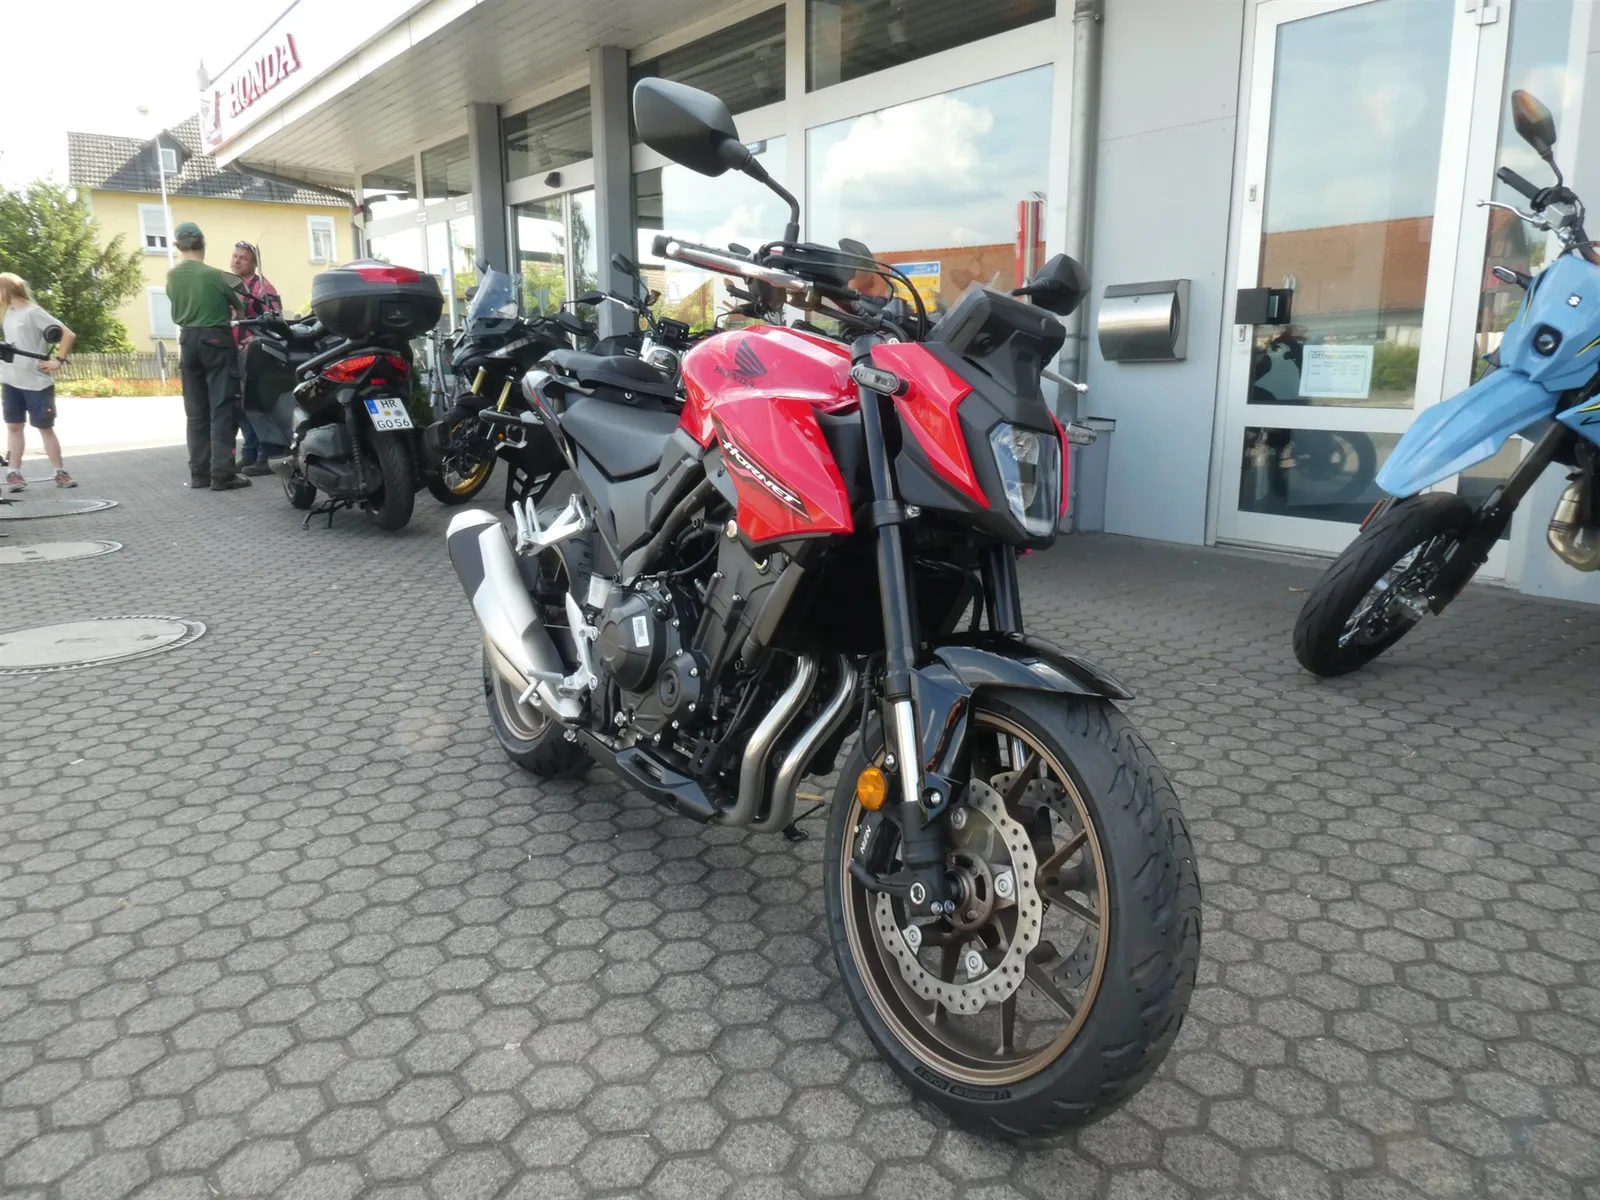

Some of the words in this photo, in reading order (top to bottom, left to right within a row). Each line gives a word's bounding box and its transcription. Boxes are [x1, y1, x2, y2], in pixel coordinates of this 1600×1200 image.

[229, 33, 302, 118] HONDA
[714, 364, 755, 388] HONDA
[380, 400, 397, 408] HR
[394, 418, 410, 427] 56
[722, 439, 802, 504] HORNET
